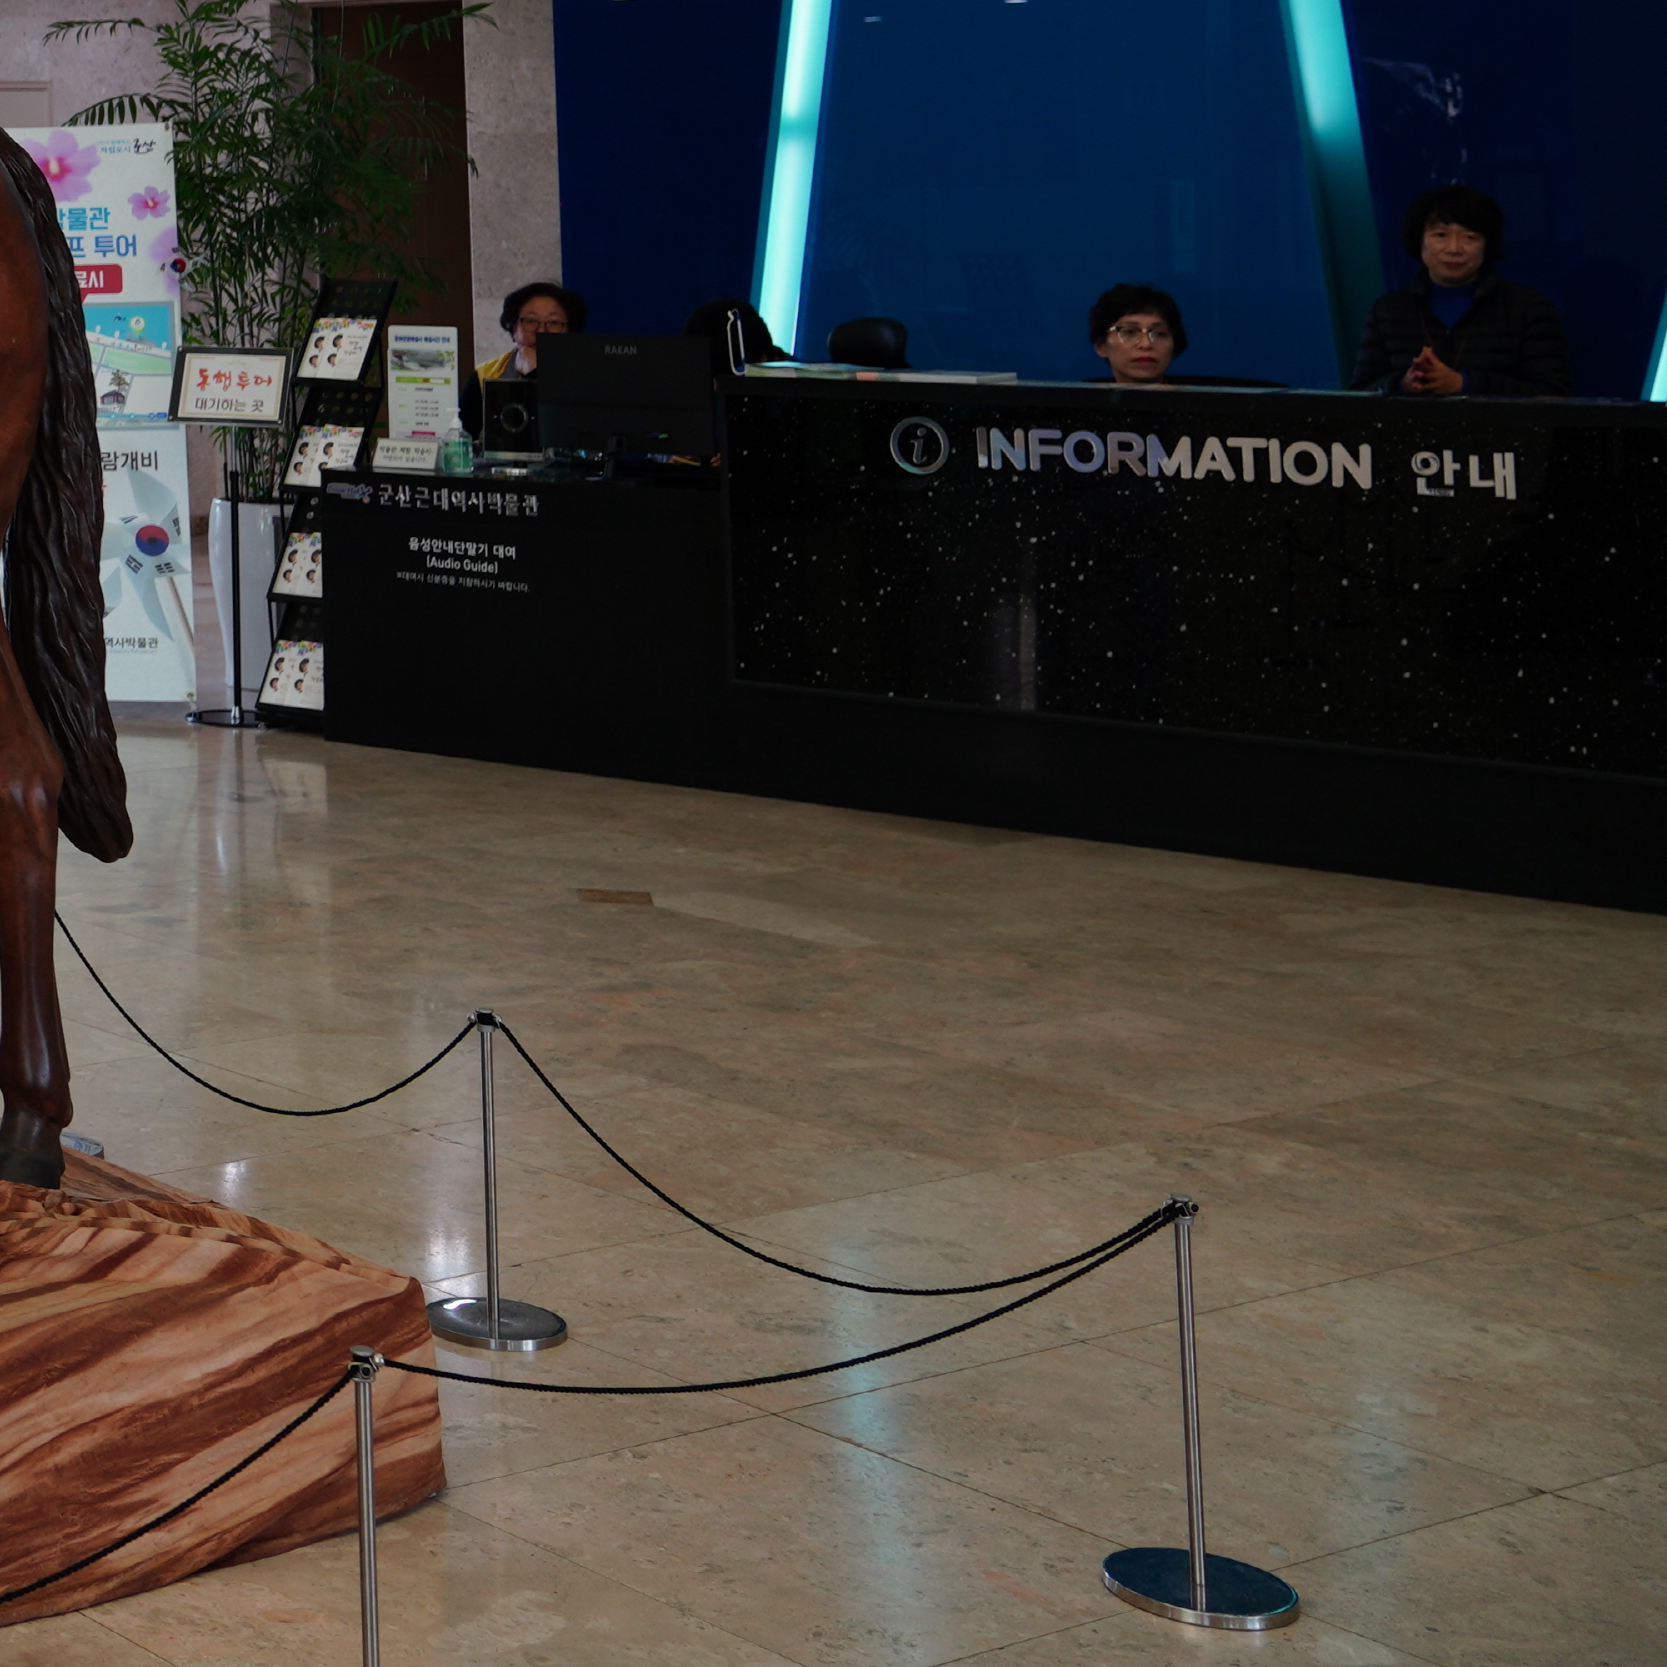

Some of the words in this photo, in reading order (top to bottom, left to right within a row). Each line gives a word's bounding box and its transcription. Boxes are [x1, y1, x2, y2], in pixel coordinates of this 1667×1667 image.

[94, 234, 137, 258] 투어
[195, 397, 246, 412] 대기하는
[251, 399, 264, 413] 곳
[101, 450, 159, 471] 람개비
[975, 427, 1372, 490] INFORMATION
[1411, 449, 1517, 500] 안내
[378, 484, 540, 517] 군산근대역사박물관
[408, 536, 489, 559] 음성안내단말기
[492, 545, 517, 560] 대여
[426, 556, 461, 571] (Audio
[463, 558, 499, 575] Guide)
